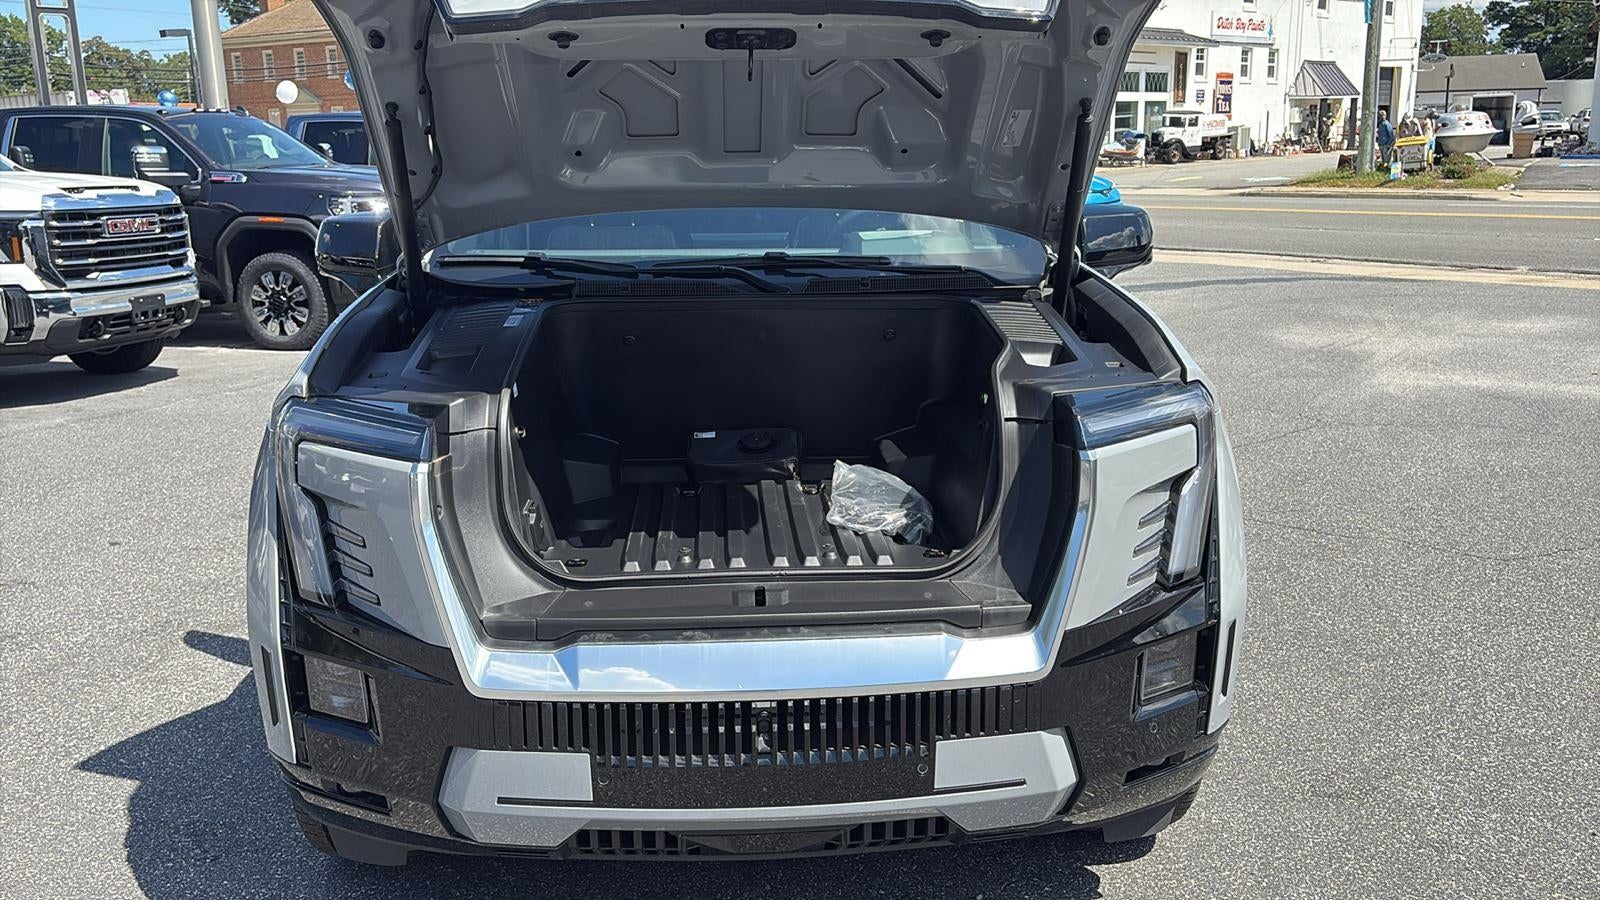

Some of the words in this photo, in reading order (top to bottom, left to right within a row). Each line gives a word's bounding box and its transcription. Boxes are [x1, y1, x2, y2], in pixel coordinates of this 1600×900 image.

[1217, 16, 1233, 29] Dutch
[1236, 17, 1247, 34] Boy
[1247, 18, 1266, 31] Paints
[108, 217, 158, 233] GMC
